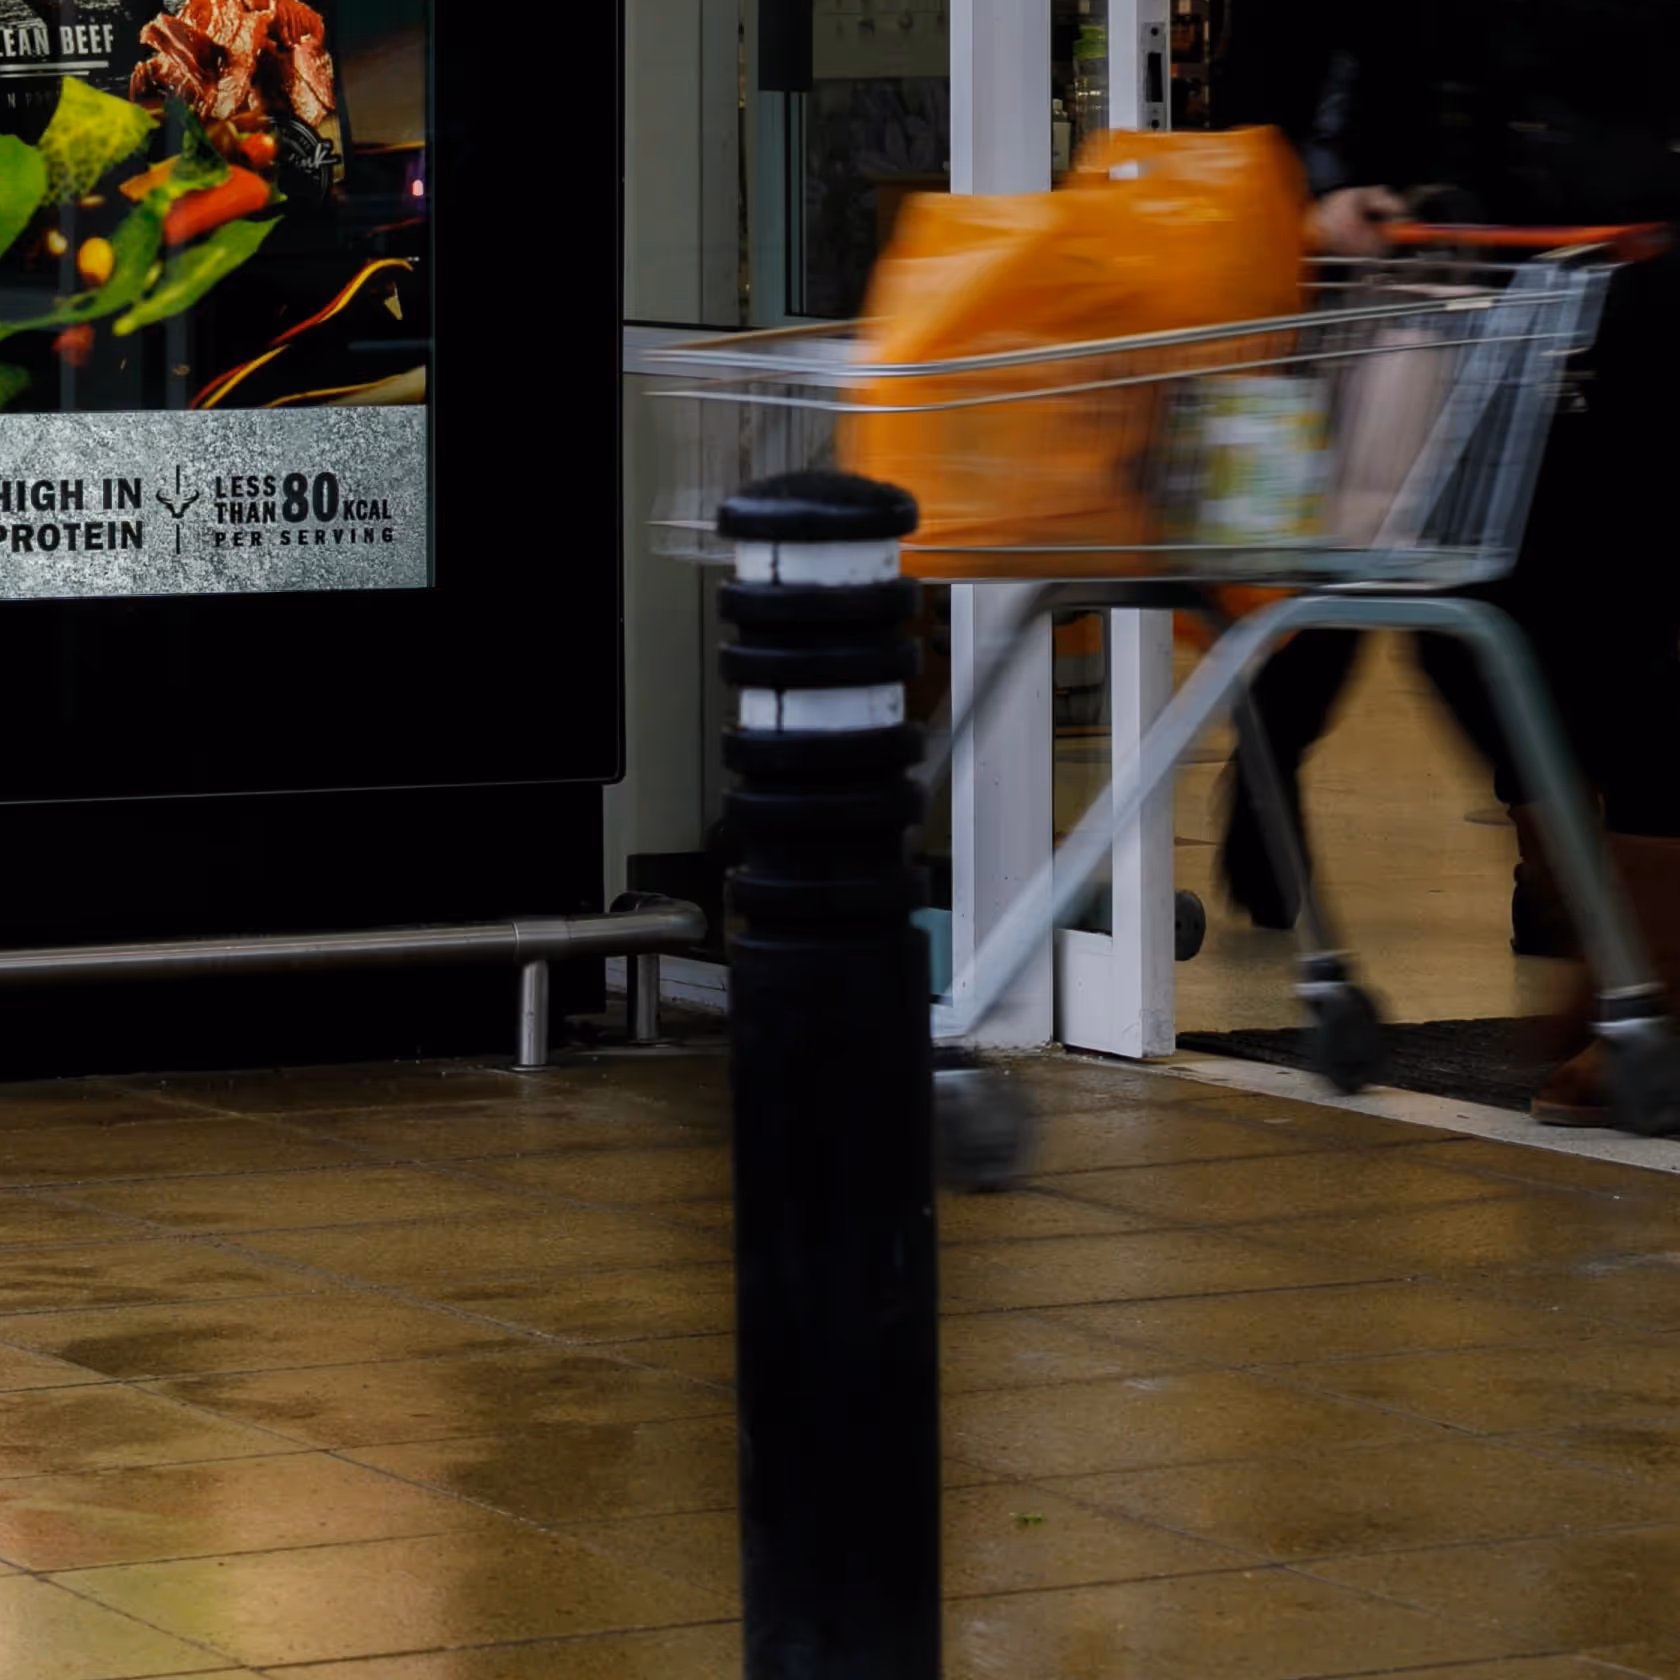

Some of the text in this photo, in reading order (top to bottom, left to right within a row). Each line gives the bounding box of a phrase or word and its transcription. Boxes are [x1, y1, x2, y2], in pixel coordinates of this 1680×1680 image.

[59, 23, 114, 55] BEEF
[102, 477, 142, 510] IN
[216, 475, 277, 498] LESS
[282, 470, 340, 523] 80
[216, 499, 392, 524] THAN KCAL
[215, 527, 395, 548] PER SERVING
